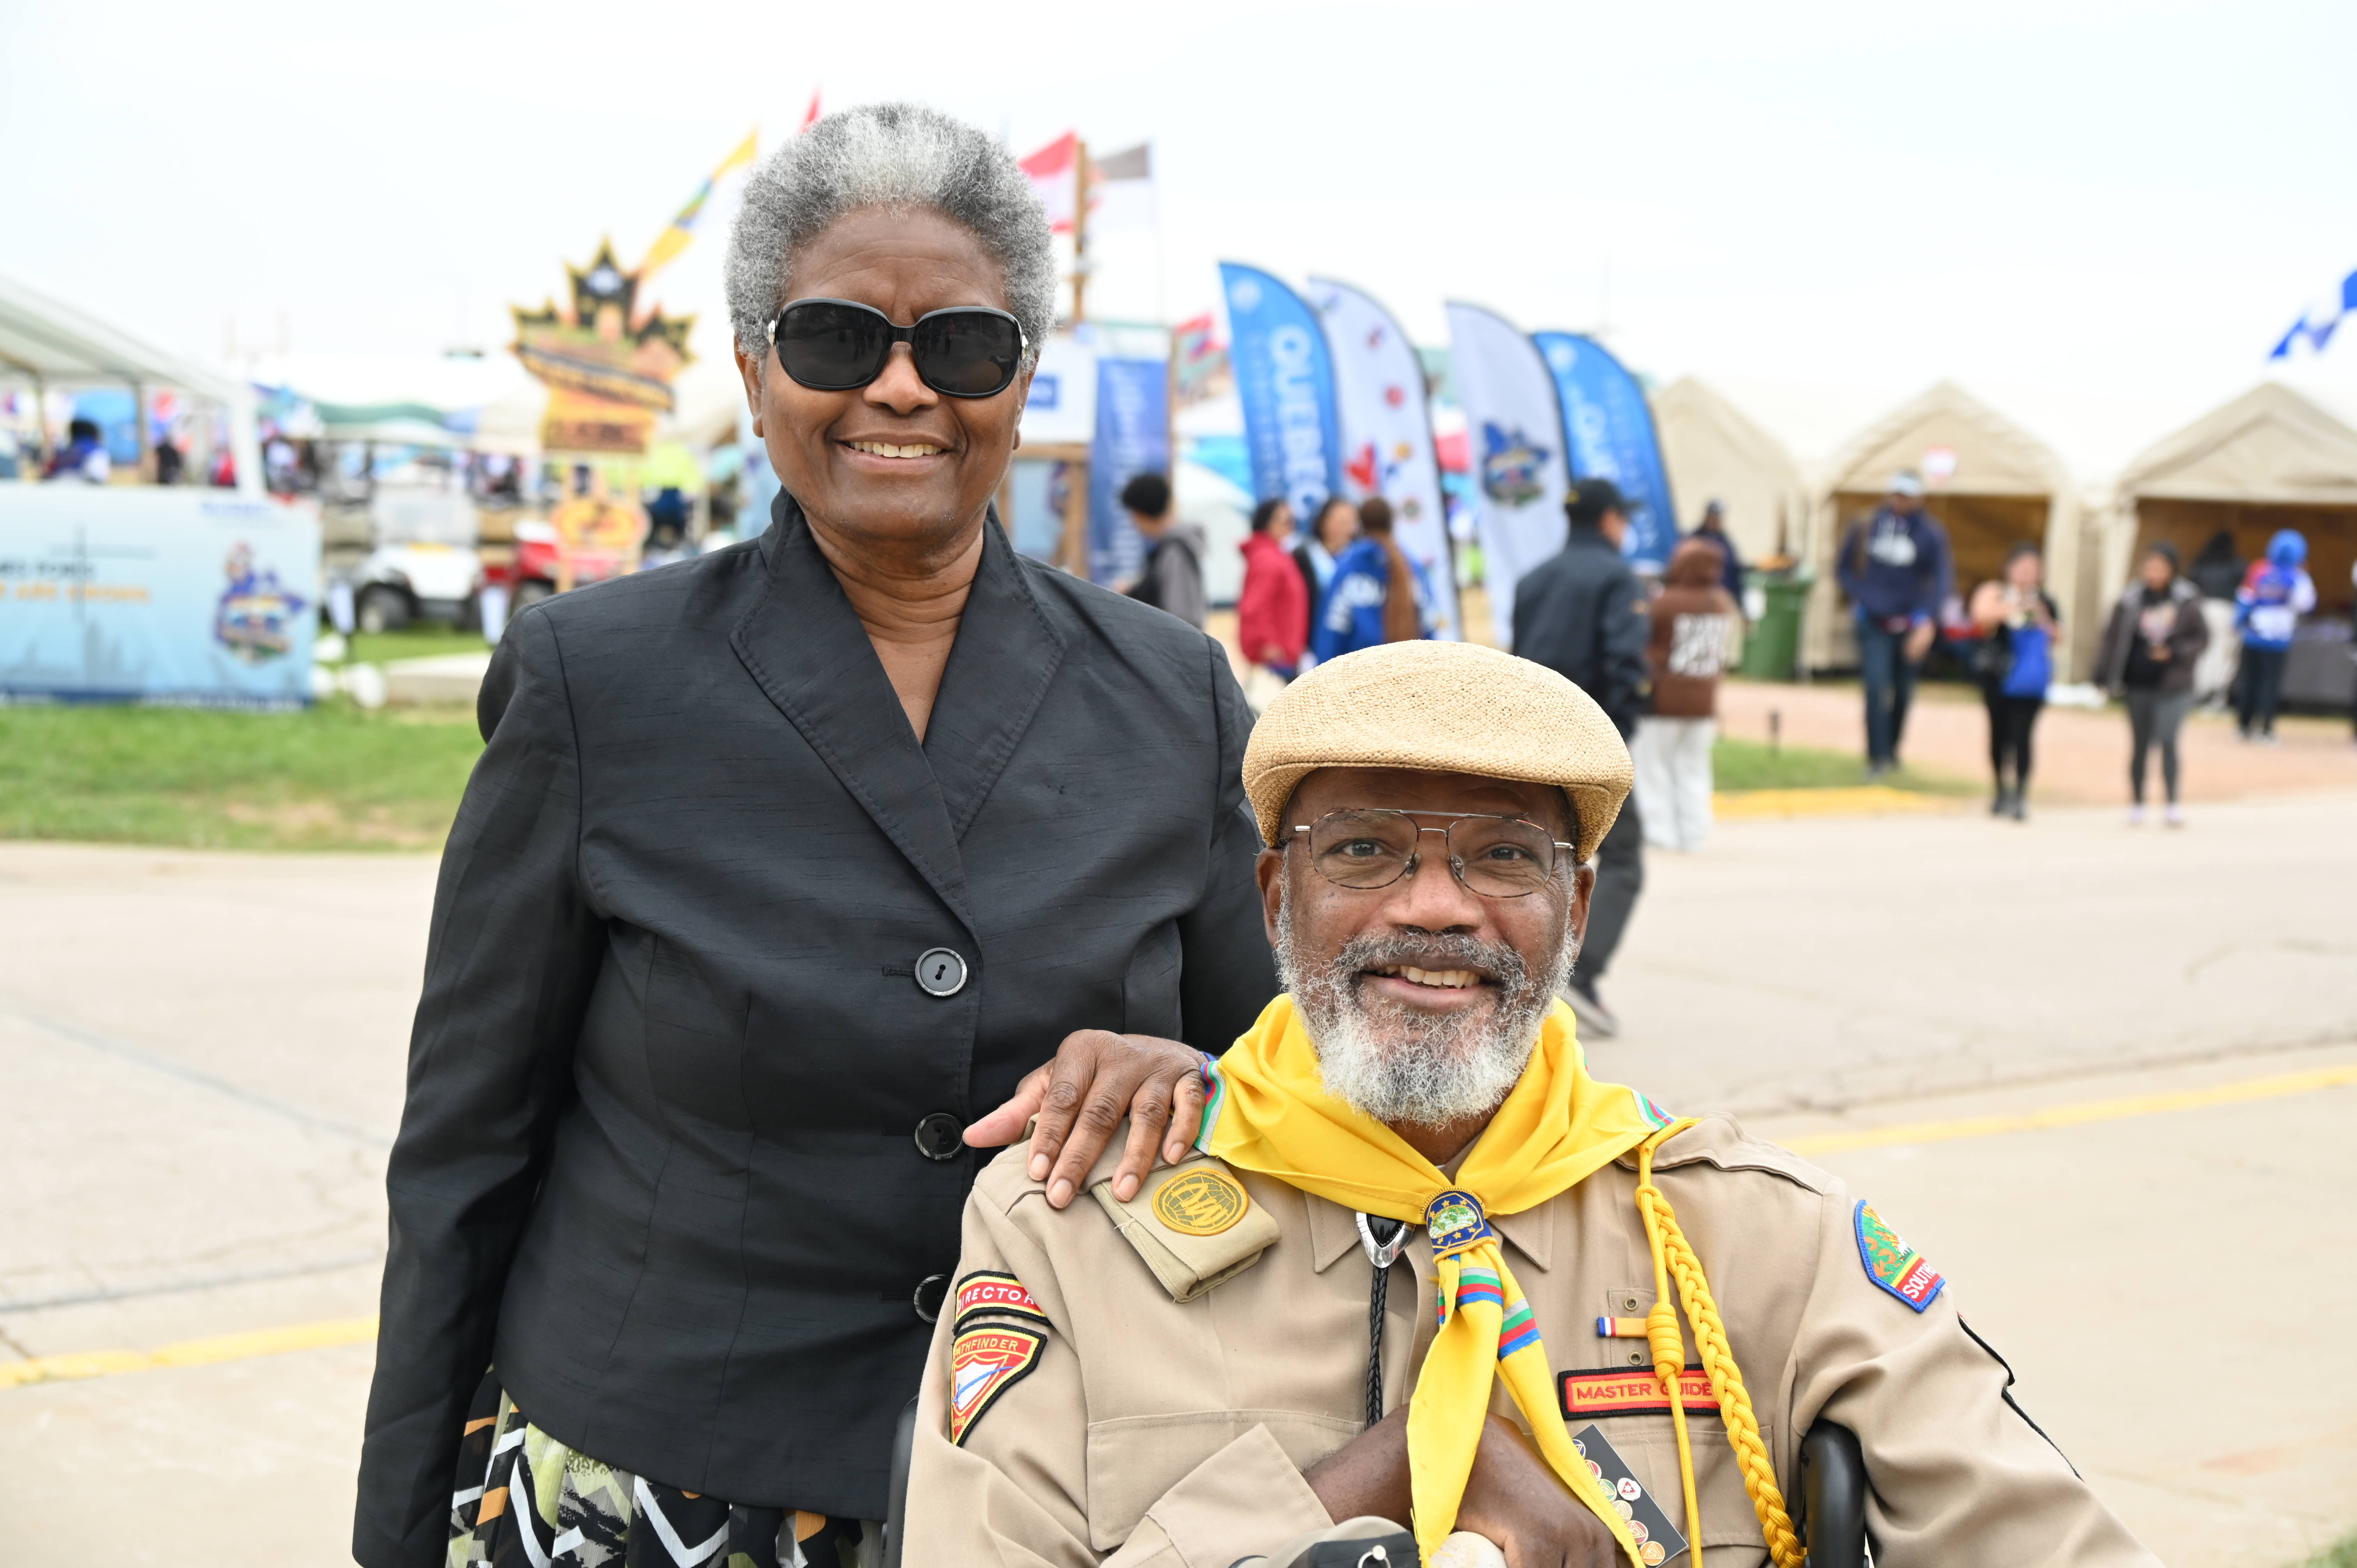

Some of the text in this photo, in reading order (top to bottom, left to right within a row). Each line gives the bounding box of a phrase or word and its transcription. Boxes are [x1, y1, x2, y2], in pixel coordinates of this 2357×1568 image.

[955, 1337, 1018, 1358] PATHFINDER
[1577, 1384, 1651, 1399] MASTER
[954, 1416, 966, 1428] CLUB
